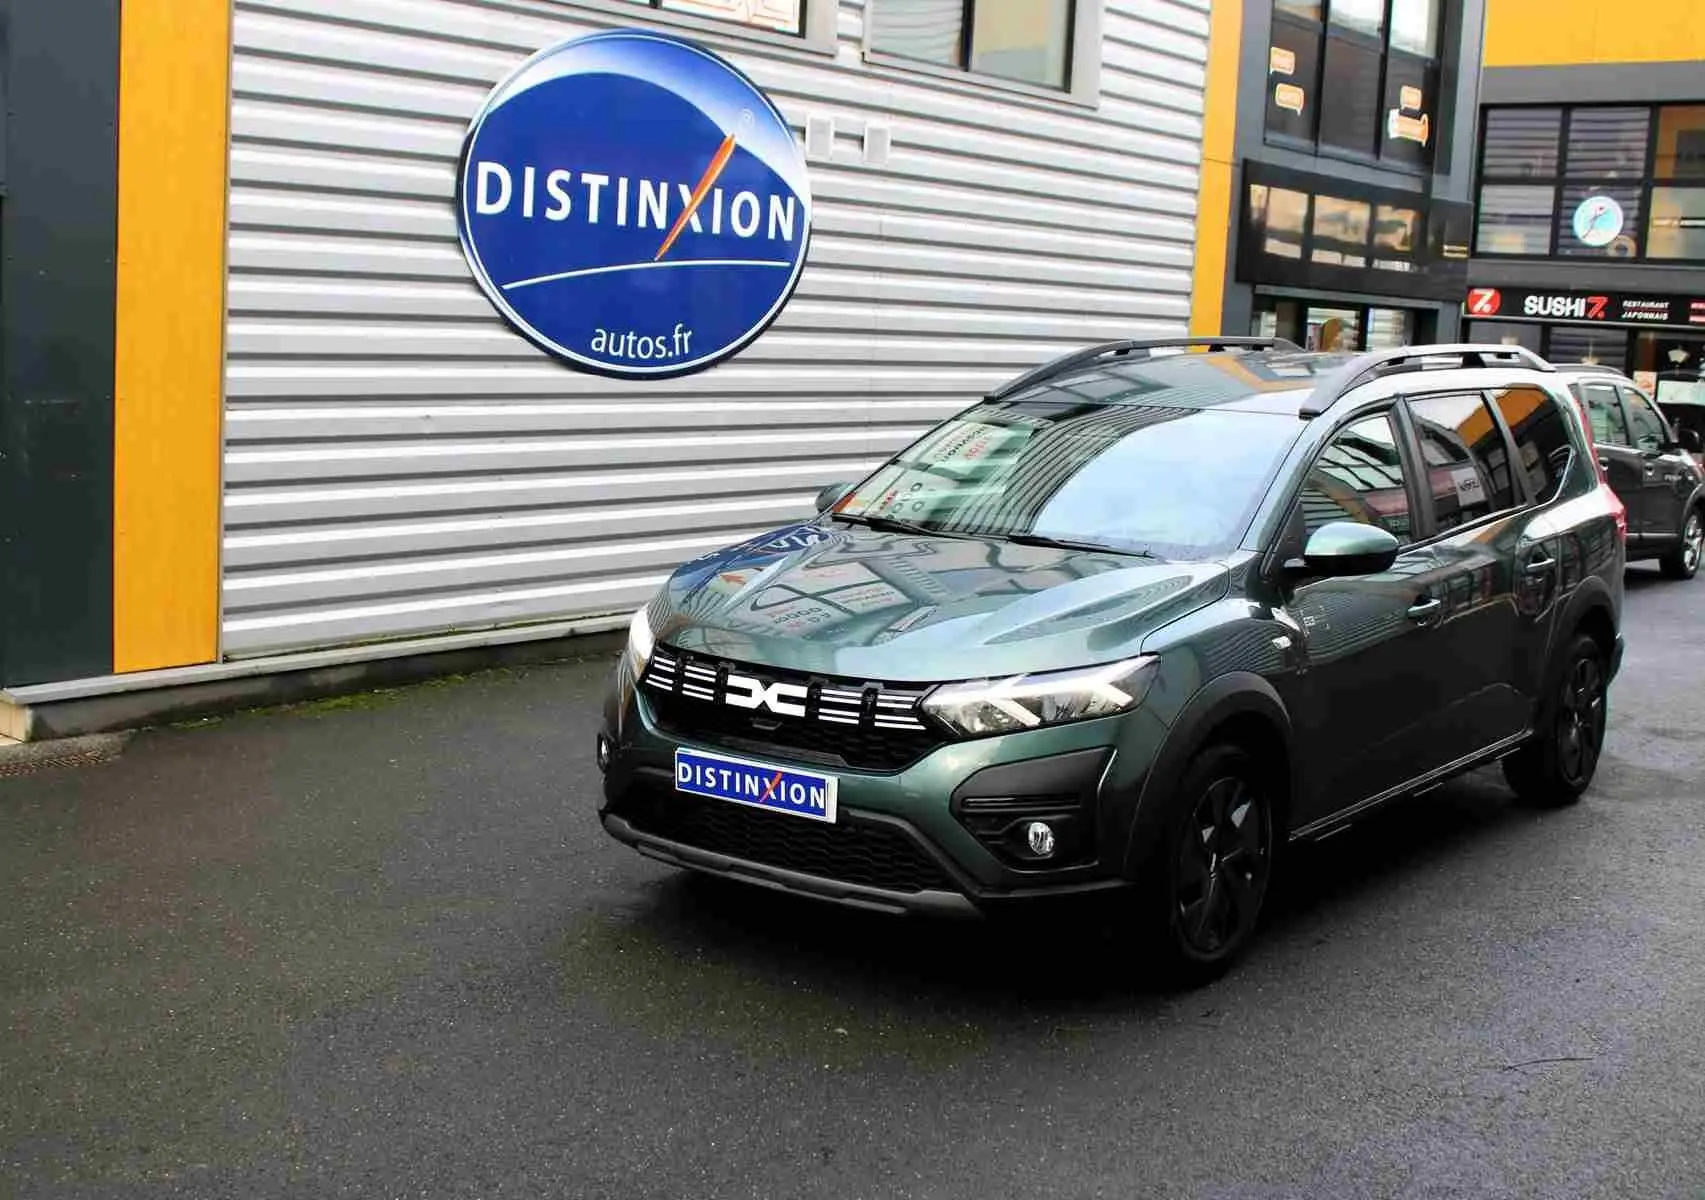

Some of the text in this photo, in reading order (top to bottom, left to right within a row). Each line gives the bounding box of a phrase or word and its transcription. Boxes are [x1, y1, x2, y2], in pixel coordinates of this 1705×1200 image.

[475, 160, 796, 256] DISTINXION
[591, 323, 693, 360] autos.fr
[677, 762, 826, 809] DISTINXION
